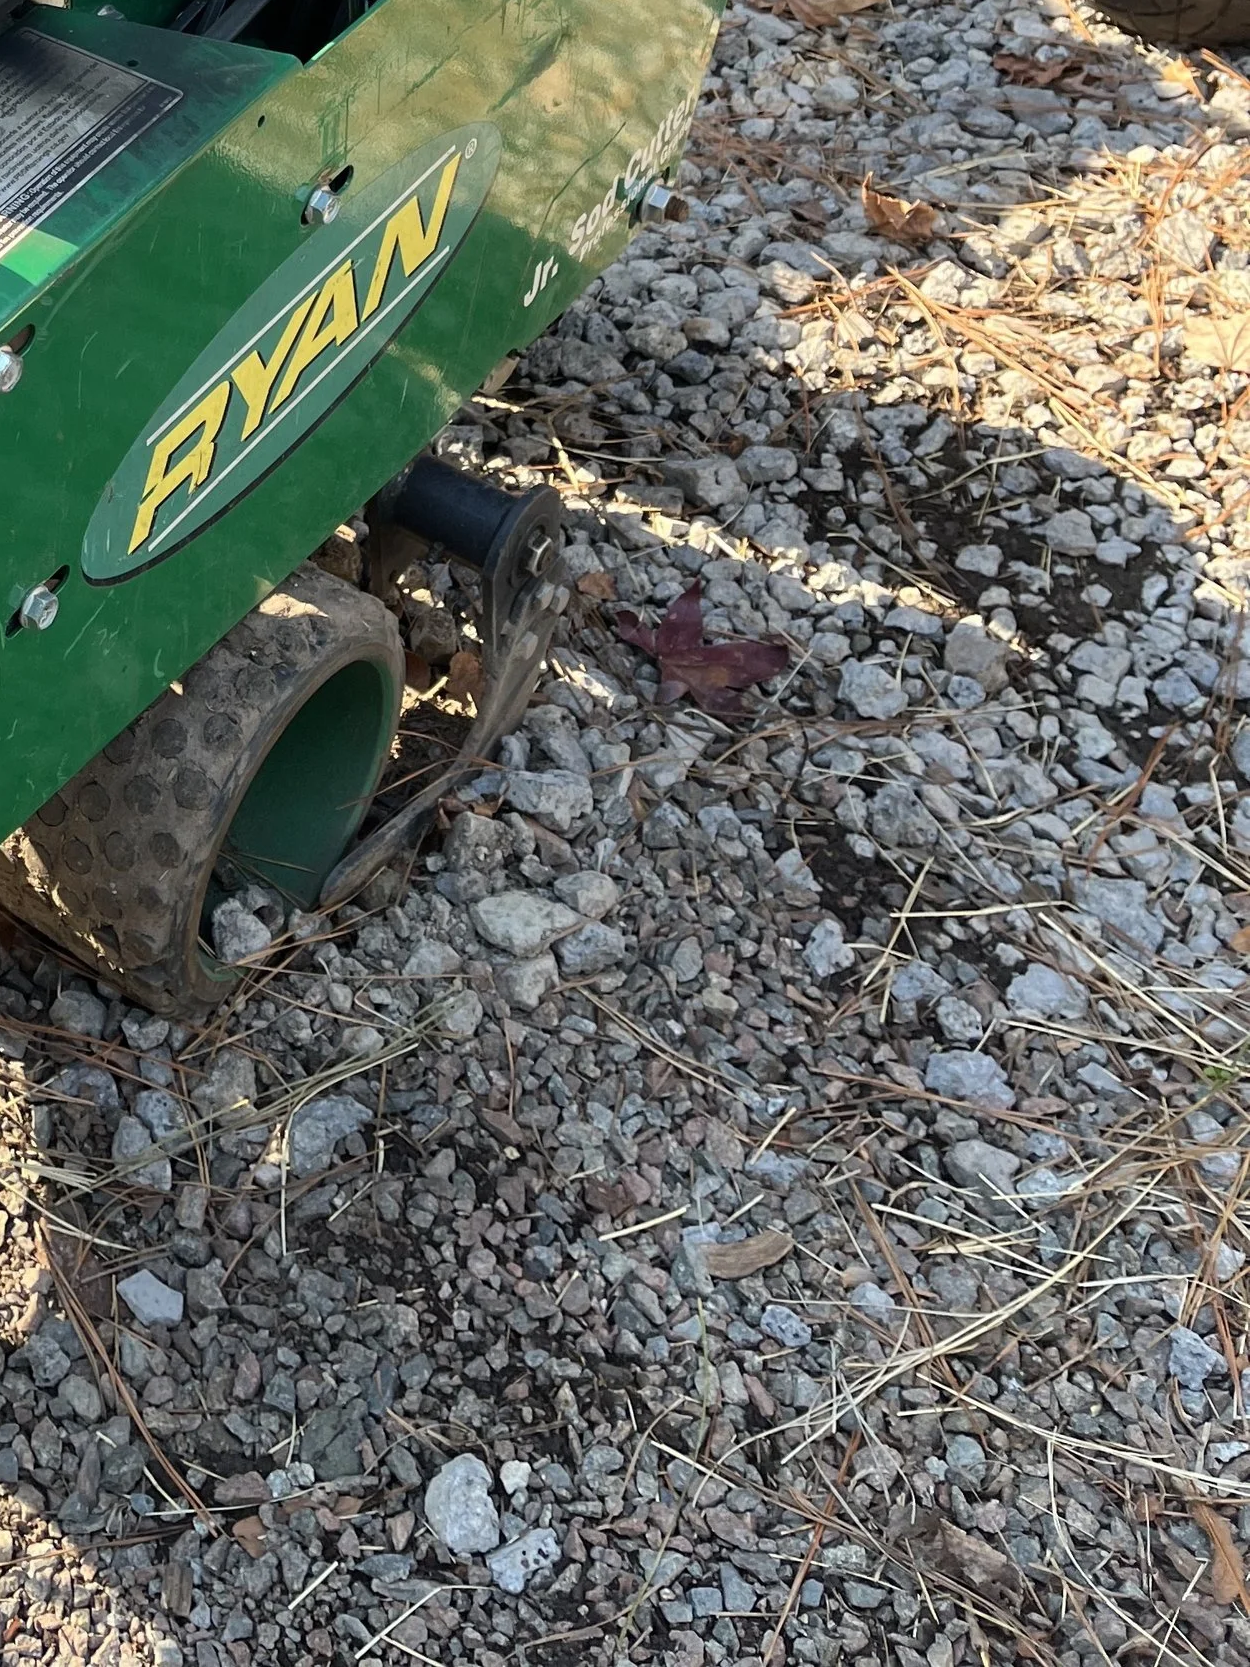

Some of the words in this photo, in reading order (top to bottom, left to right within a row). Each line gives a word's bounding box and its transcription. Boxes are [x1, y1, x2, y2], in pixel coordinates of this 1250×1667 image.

[523, 254, 559, 308] Jr.
[568, 173, 620, 257] Sod
[623, 84, 696, 191] Cutter
[127, 151, 462, 556] RYAN
